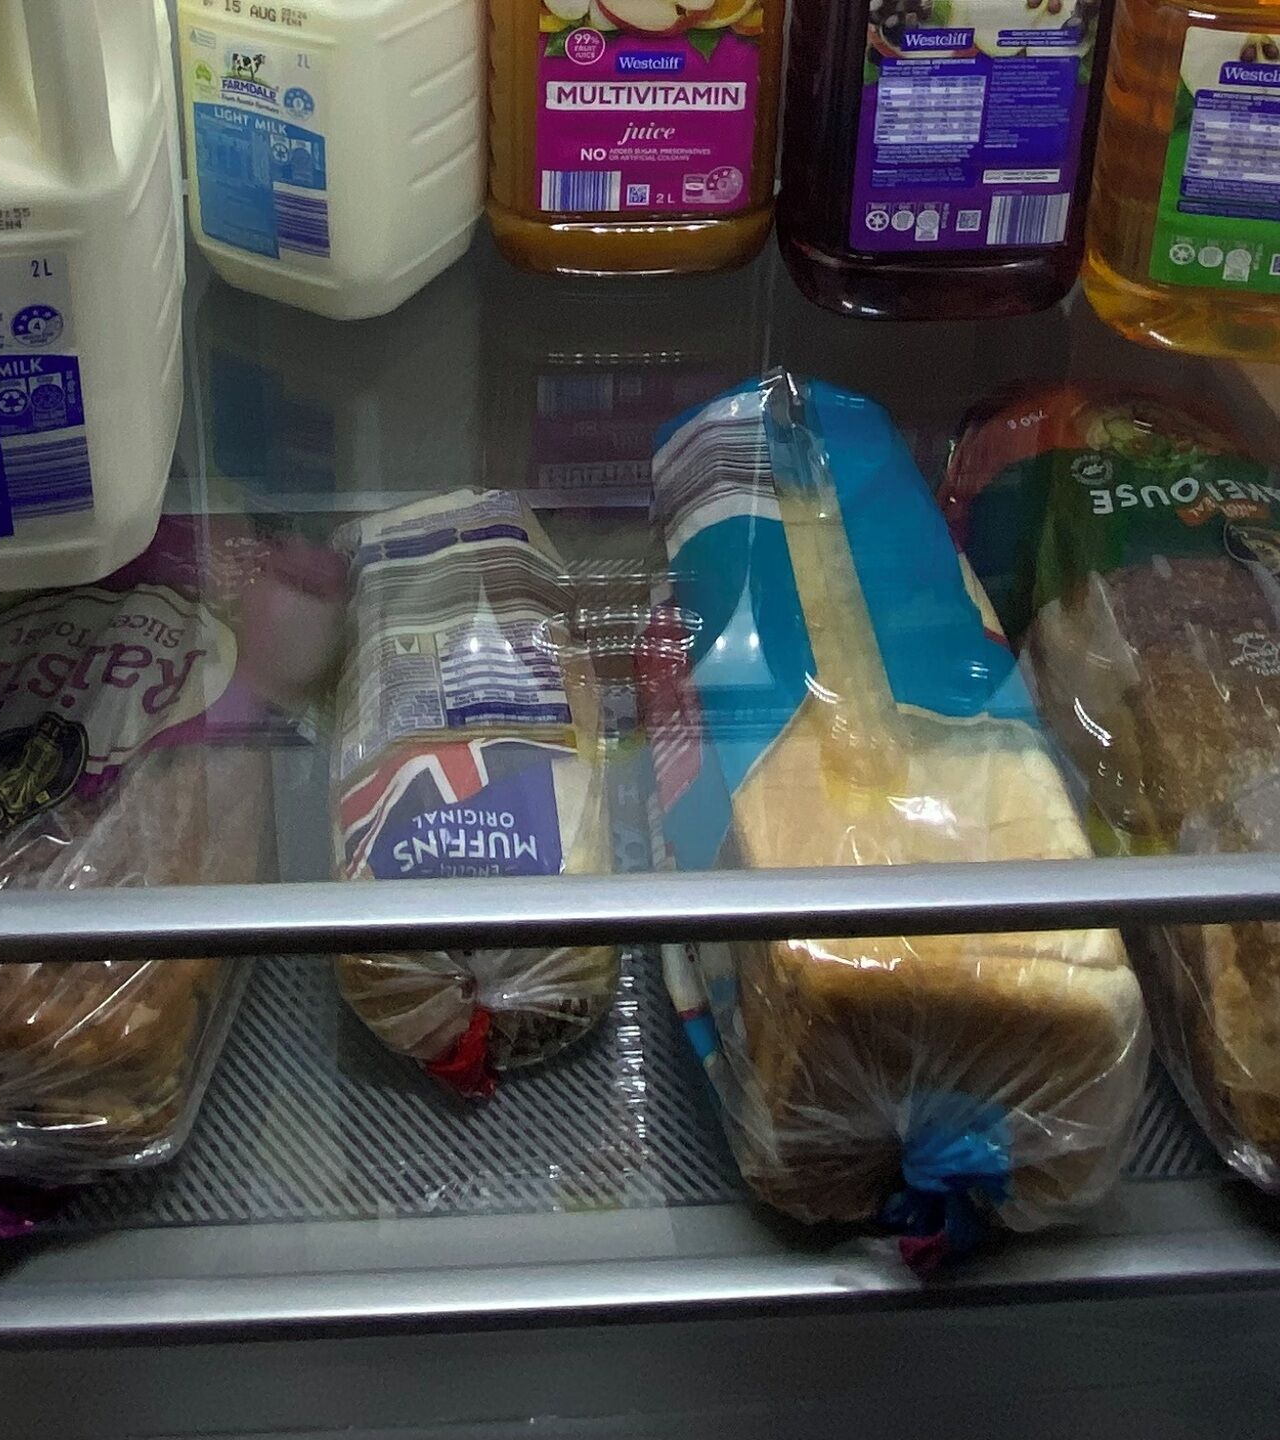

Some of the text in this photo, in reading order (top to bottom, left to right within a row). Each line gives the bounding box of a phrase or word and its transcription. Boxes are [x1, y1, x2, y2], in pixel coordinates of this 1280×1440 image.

[224, 0, 277, 23] 15 AUG
[905, 31, 968, 47] Westcliff
[619, 56, 681, 70] Westcliff
[222, 79, 277, 101] FARMDALE
[556, 86, 740, 106] MULTIVITAMIN
[214, 106, 287, 136] LIGHT MILK
[617, 122, 675, 145] juice
[581, 148, 606, 161] NO
[412, 809, 516, 827] ORIGINAL
[392, 828, 538, 873] MUFFINS
